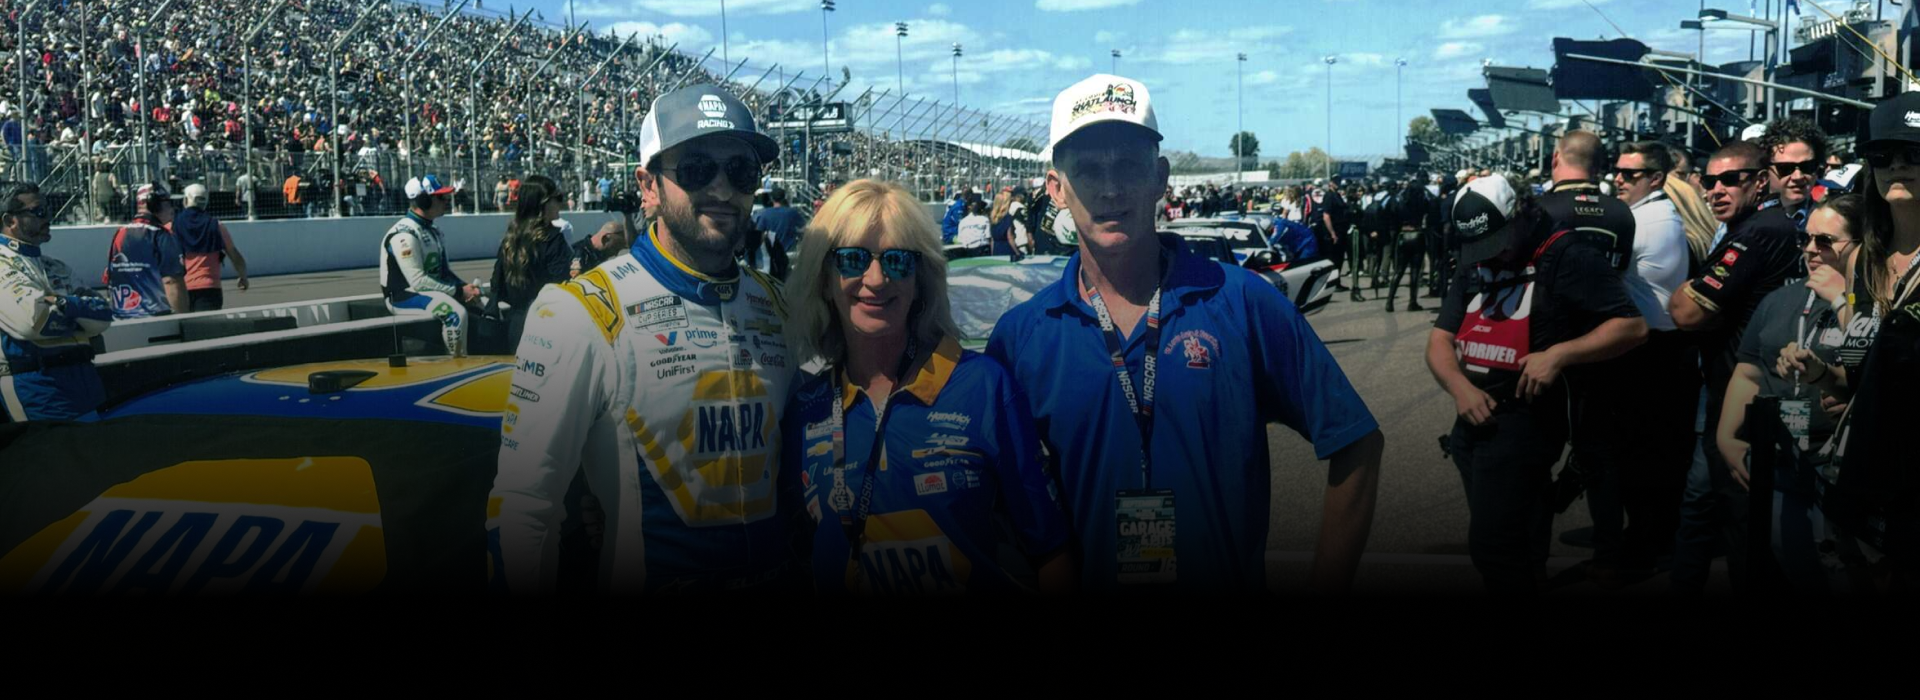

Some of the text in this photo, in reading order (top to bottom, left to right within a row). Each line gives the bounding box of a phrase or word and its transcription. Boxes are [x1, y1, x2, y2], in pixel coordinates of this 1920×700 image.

[702, 101, 725, 112] NAPA
[697, 119, 728, 129] RACING
[1574, 207, 1604, 215] LEGACY
[644, 297, 673, 310] NASCAR
[638, 308, 678, 324] CUP SERIES
[1092, 297, 1114, 331] NASCAR
[685, 328, 718, 341] prime
[650, 354, 697, 367] GOODYEAR
[657, 365, 696, 380] UniFirst
[1142, 354, 1157, 401] NASCAR
[1117, 370, 1139, 414] NASCAR
[698, 402, 766, 453] NAPA
[924, 457, 970, 468] GOODYEAR
[834, 467, 850, 511] NASCAR
[857, 473, 875, 521] NASCAR
[1119, 520, 1172, 537] GARAGE
[38, 508, 341, 599] NAPA
[861, 544, 957, 598] NAPA
[1121, 562, 1150, 573] ROUND
